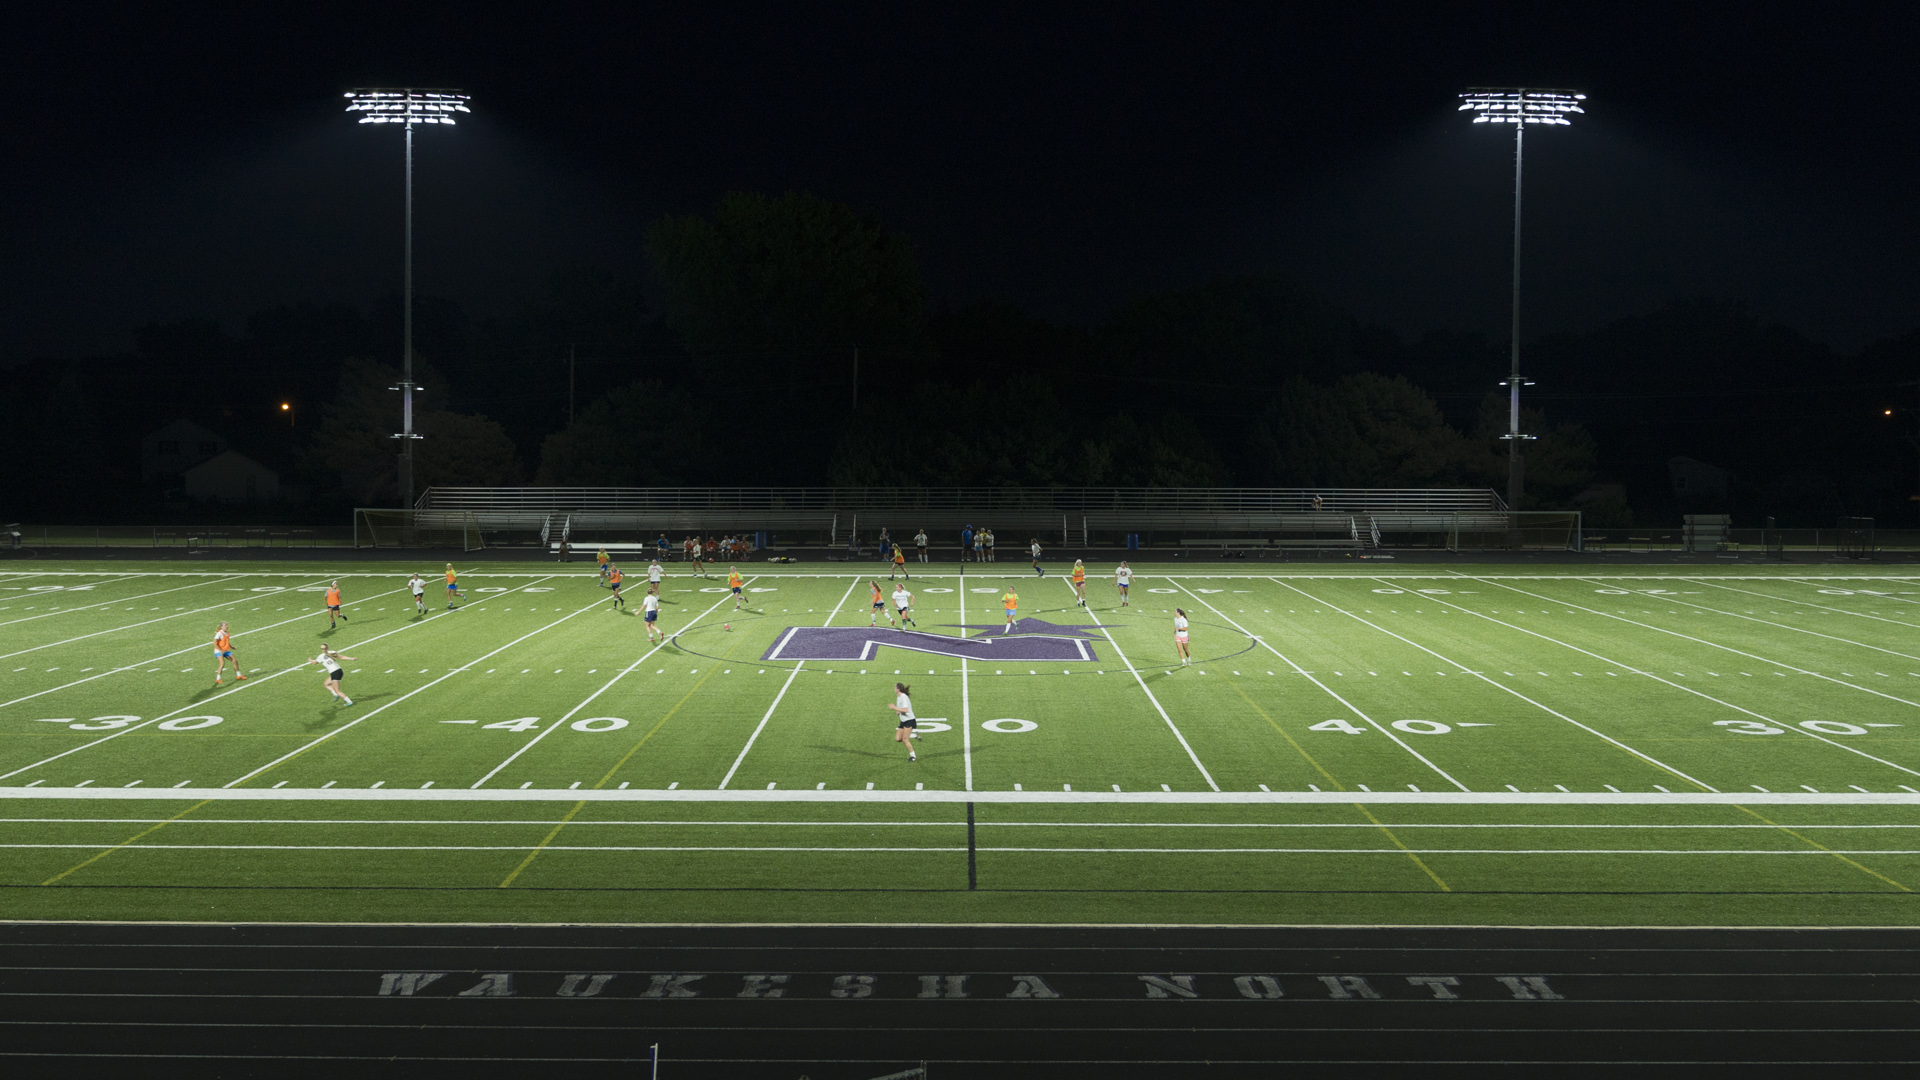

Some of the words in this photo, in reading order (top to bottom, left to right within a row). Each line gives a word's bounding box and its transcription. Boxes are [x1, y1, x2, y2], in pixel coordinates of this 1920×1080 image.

[481, 716, 629, 732] 40
[1308, 719, 1452, 734] 40
[1712, 720, 1868, 735] 30
[377, 973, 1061, 999] WAUKESHA
[1137, 974, 1566, 1000] NORTH
